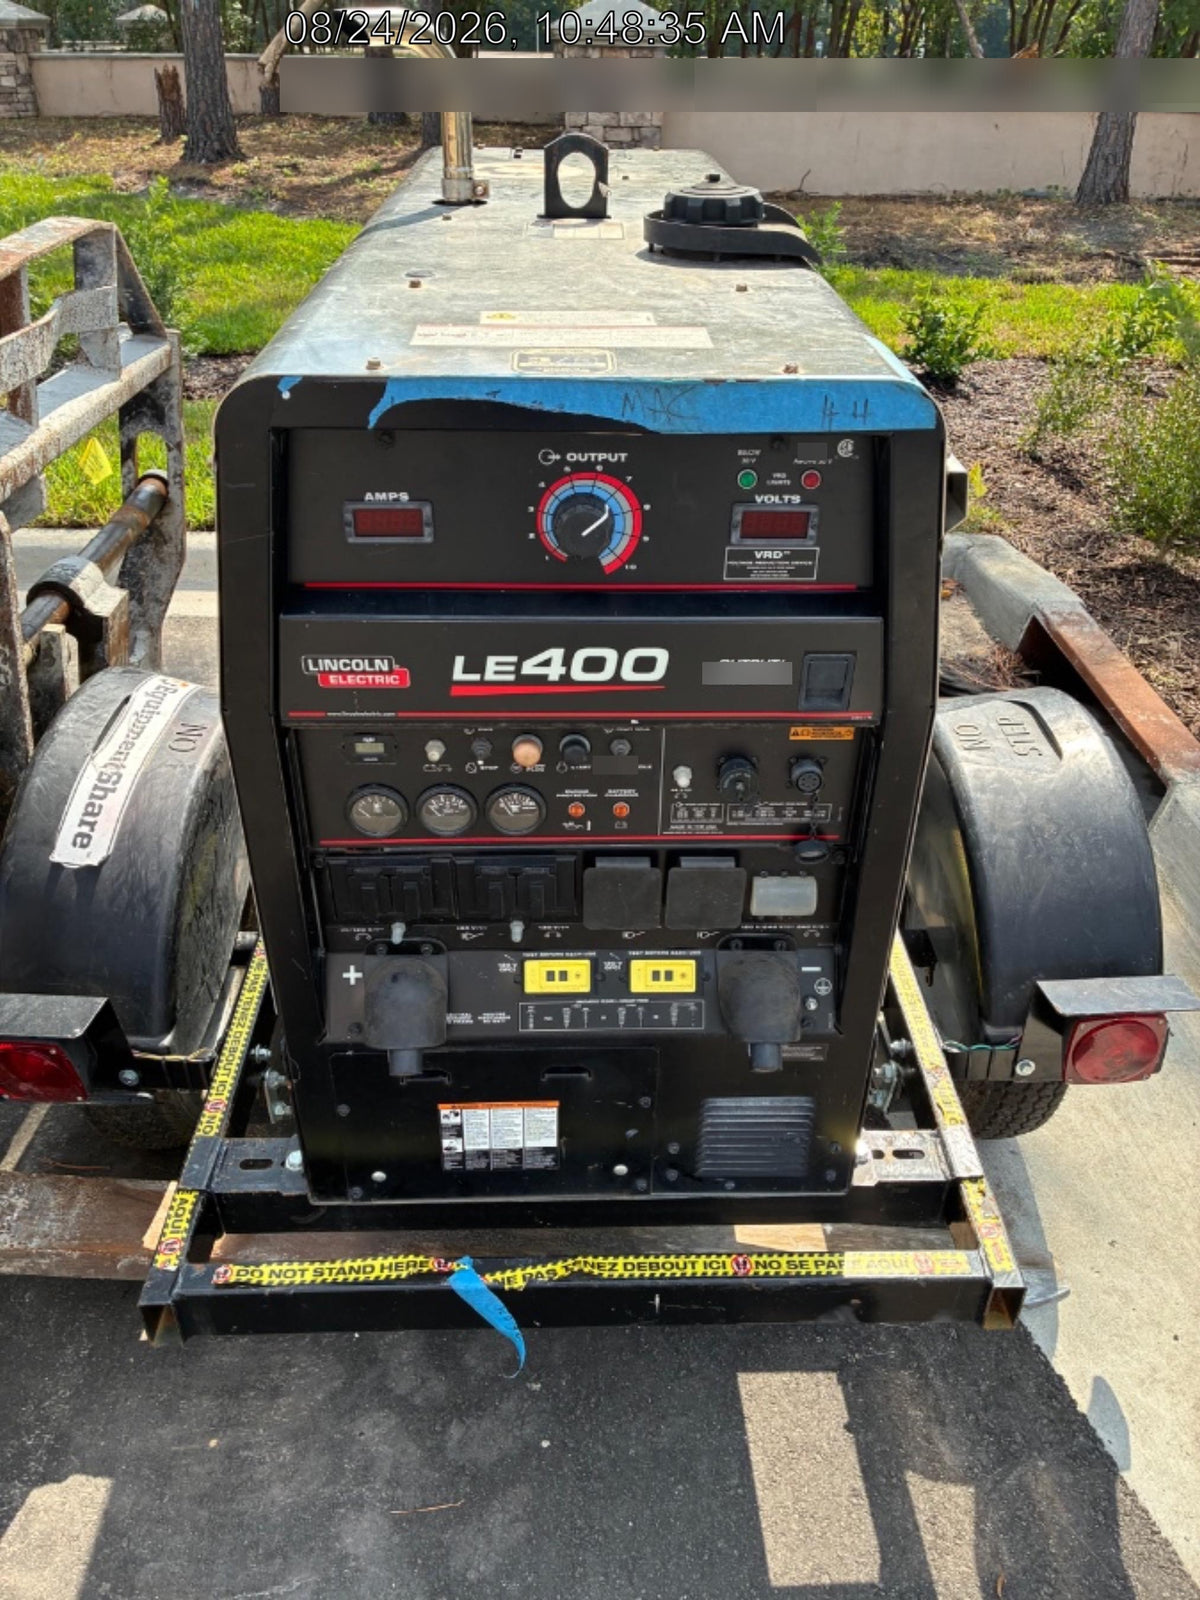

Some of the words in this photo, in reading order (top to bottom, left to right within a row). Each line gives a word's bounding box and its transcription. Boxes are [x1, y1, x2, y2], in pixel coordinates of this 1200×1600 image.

[566, 452, 628, 462] OUTPUT
[364, 491, 409, 502] AMPS
[755, 494, 801, 504] VOLTS
[307, 658, 390, 672] LINCOLN
[452, 647, 670, 682] LE400
[329, 674, 401, 685] ELECTRIC
[168, 722, 208, 753] NO
[953, 724, 991, 751] NO
[996, 716, 1043, 757] STEP
[235, 997, 257, 1028] TENEZ
[218, 1031, 245, 1079] DEBOUT
[213, 1080, 230, 1097] ICI
[201, 1116, 217, 1136] NO
[235, 1269, 264, 1280] DO
[264, 1268, 305, 1280] NOT
[313, 1263, 376, 1278] STAND
[379, 1259, 430, 1273] HERE
[623, 1260, 699, 1272] DEBOUT
[704, 1260, 727, 1271] ICI
[754, 1260, 781, 1270] NO
[786, 1260, 810, 1270] SE
